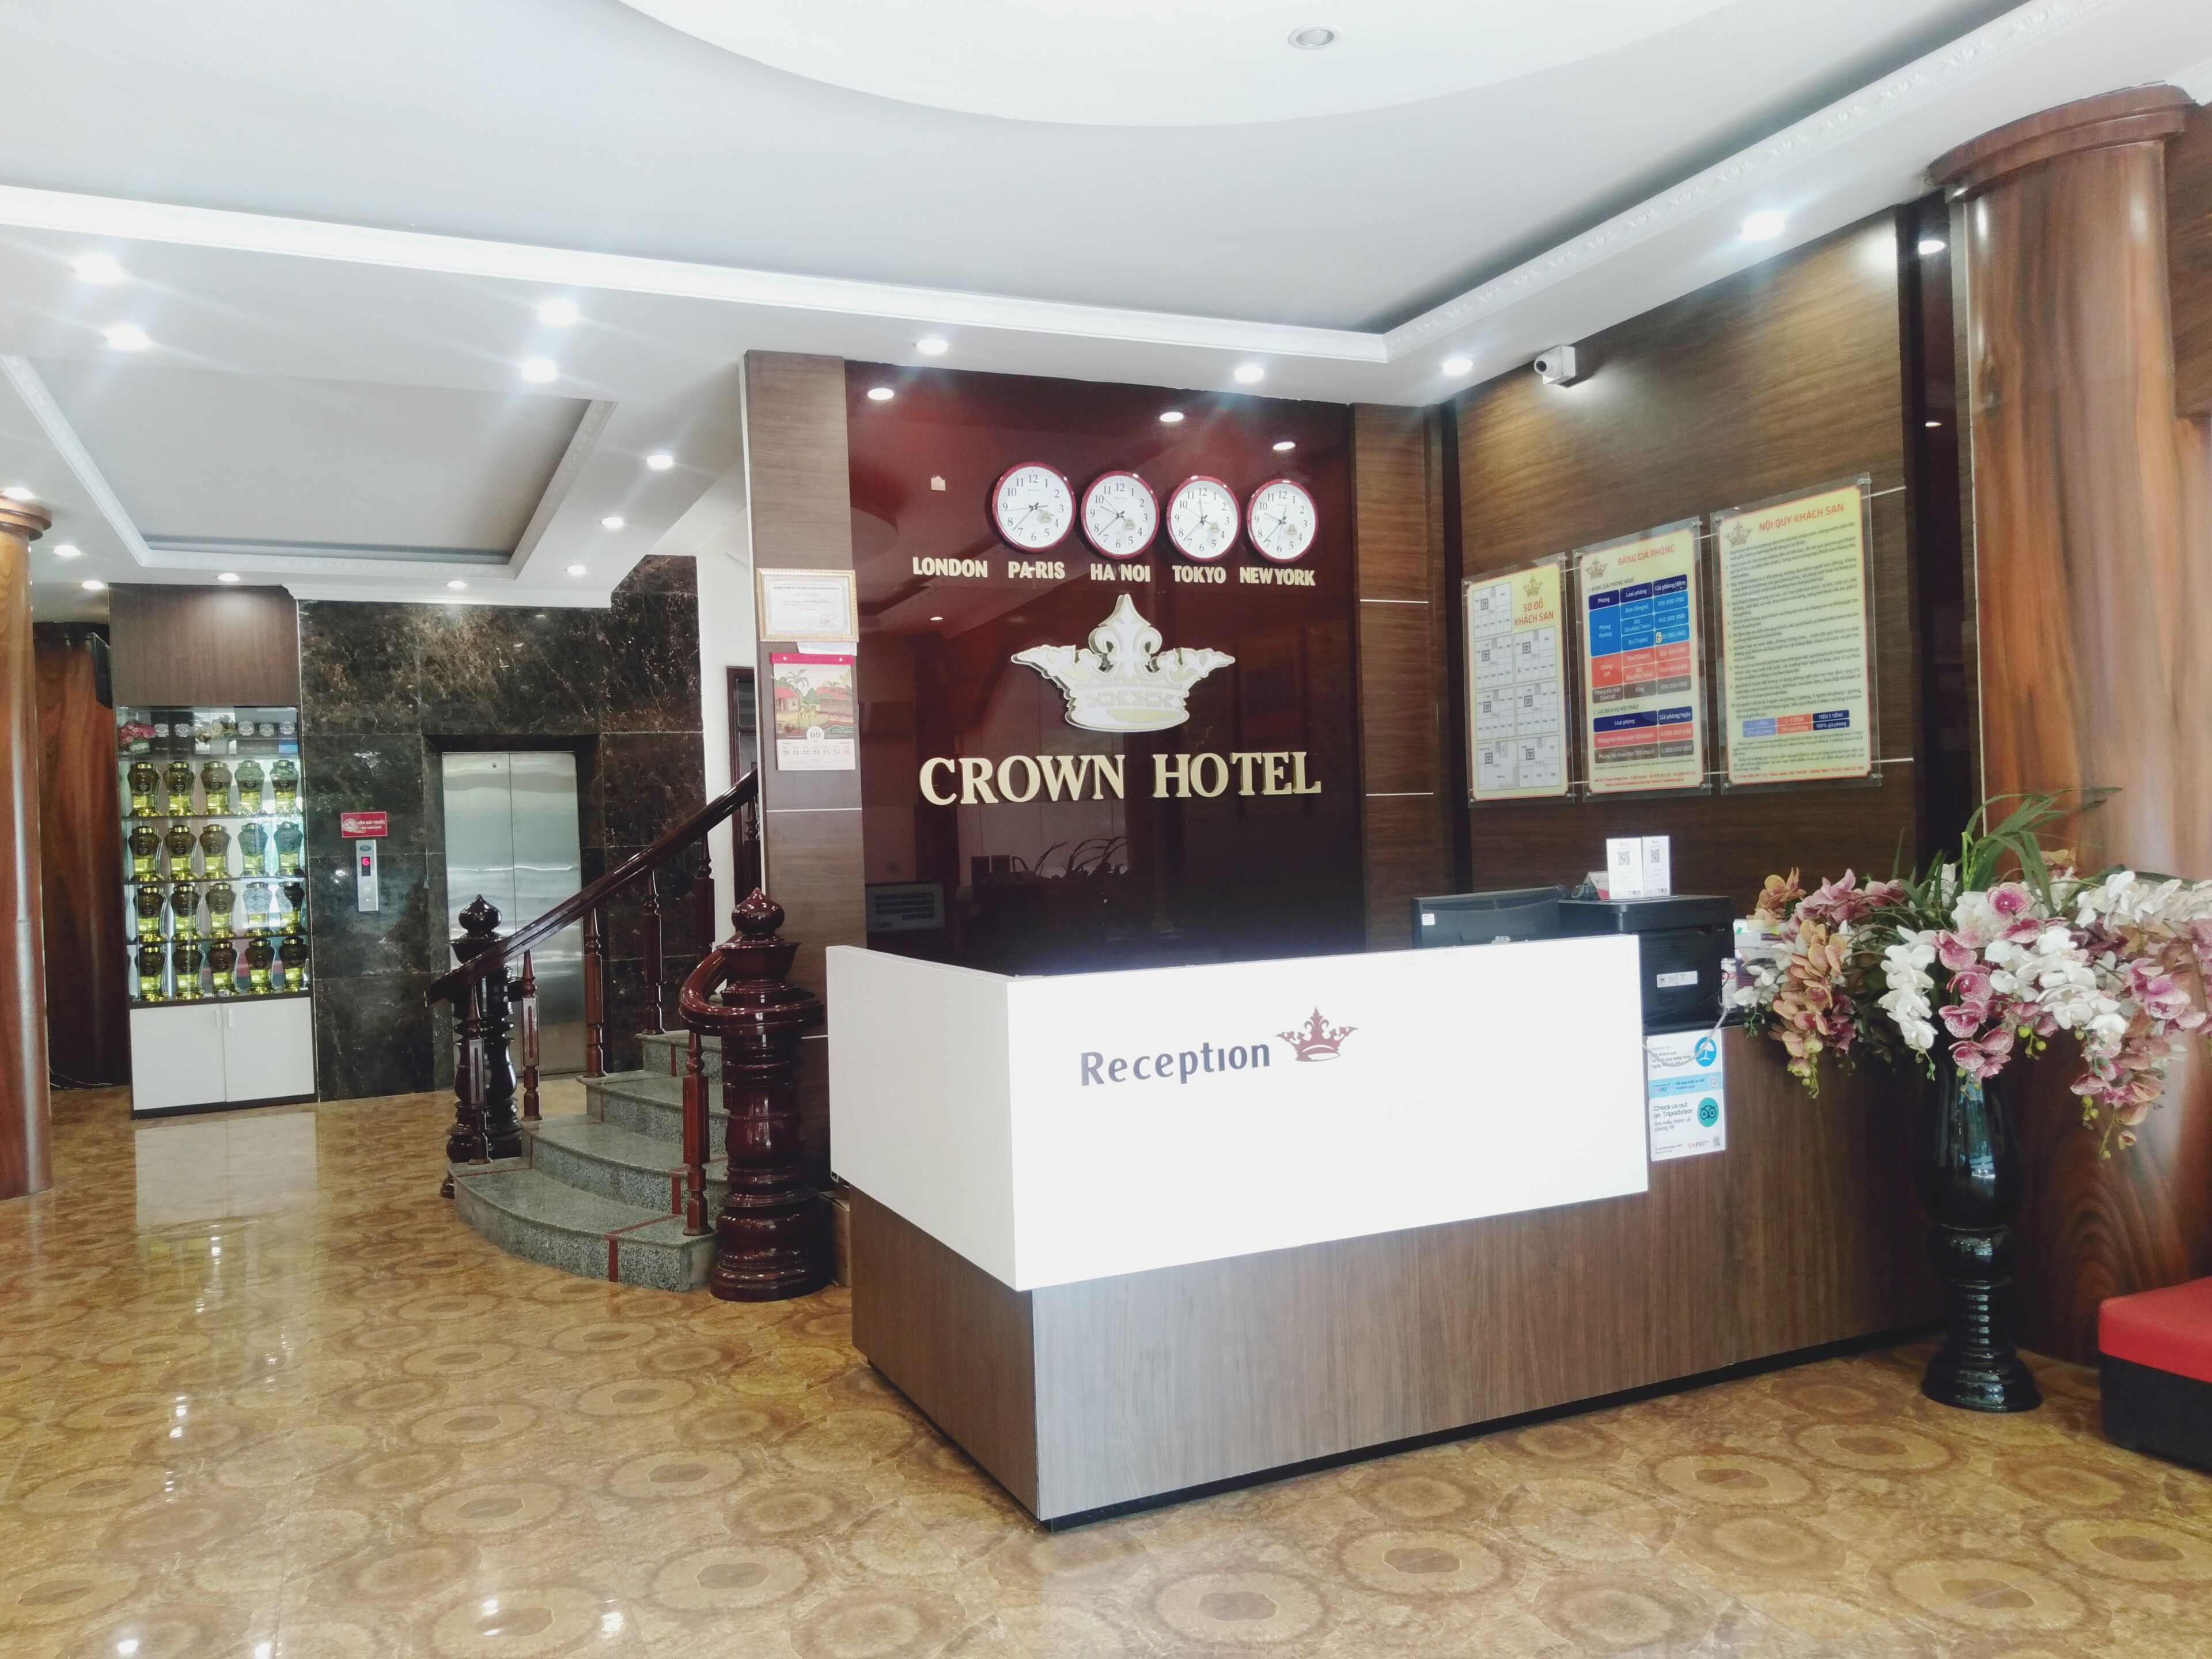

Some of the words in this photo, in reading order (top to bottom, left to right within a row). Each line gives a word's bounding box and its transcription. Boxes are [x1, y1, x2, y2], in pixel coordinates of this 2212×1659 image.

[1016, 478, 1024, 486] 11
[1028, 475, 1038, 483] 12
[1045, 479, 1048, 487] 1
[1104, 486, 1111, 494] 11
[1116, 483, 1124, 492] 12
[1007, 488, 1017, 497] 10
[1055, 490, 1059, 498] 2
[1131, 488, 1134, 496] 1
[1187, 491, 1194, 499] 11
[1198, 488, 1207, 496] 12
[1213, 492, 1216, 500] 1
[1278, 491, 1287, 499] 12
[1095, 495, 1104, 503] 10
[1267, 493, 1274, 501] 11
[1293, 495, 1295, 503] 1
[1003, 502, 1007, 511] 9
[1139, 499, 1144, 507] 2
[1179, 500, 1187, 508] 10
[1222, 502, 1226, 510] 2
[1259, 502, 1267, 510] 10
[1059, 505, 1064, 513] 3
[1090, 509, 1094, 517] 9
[1300, 506, 1304, 514] 2
[1007, 517, 1013, 526] 8
[1143, 513, 1147, 522] 3
[1225, 517, 1229, 525] 3
[1255, 516, 1259, 524] 9
[1775, 516, 1791, 529] QUY
[1794, 508, 1823, 523] KHÁCH
[1054, 519, 1059, 528] 4
[1017, 528, 1023, 536] 7
[1094, 524, 1099, 532] 8
[1138, 528, 1142, 536] 4
[1031, 532, 1036, 541] 6
[1044, 529, 1050, 537] 5
[1179, 529, 1183, 537] 8
[1220, 531, 1225, 539] 4
[1115, 540, 1120, 548] 6
[1128, 536, 1133, 544] 5
[1187, 539, 1192, 547] 7
[1211, 539, 1216, 548] 5
[1199, 543, 1204, 551] 6
[1277, 545, 1282, 553] 6
[1289, 541, 1293, 550] 5
[913, 557, 987, 577] LONDON
[1008, 561, 1065, 579] PARIS
[1090, 563, 1115, 581] HA
[1120, 564, 1152, 582] NOI
[1172, 565, 1226, 584] TOKYO
[1524, 601, 1532, 612] SƠ
[1514, 613, 1537, 626] KHÁCH
[920, 755, 1124, 805] CROWN
[1152, 752, 1321, 798] HOTEL
[362, 857, 369, 866] 6
[1081, 1042, 1270, 1086] Reception
[1663, 1108, 1692, 1118] Tripadvisor
